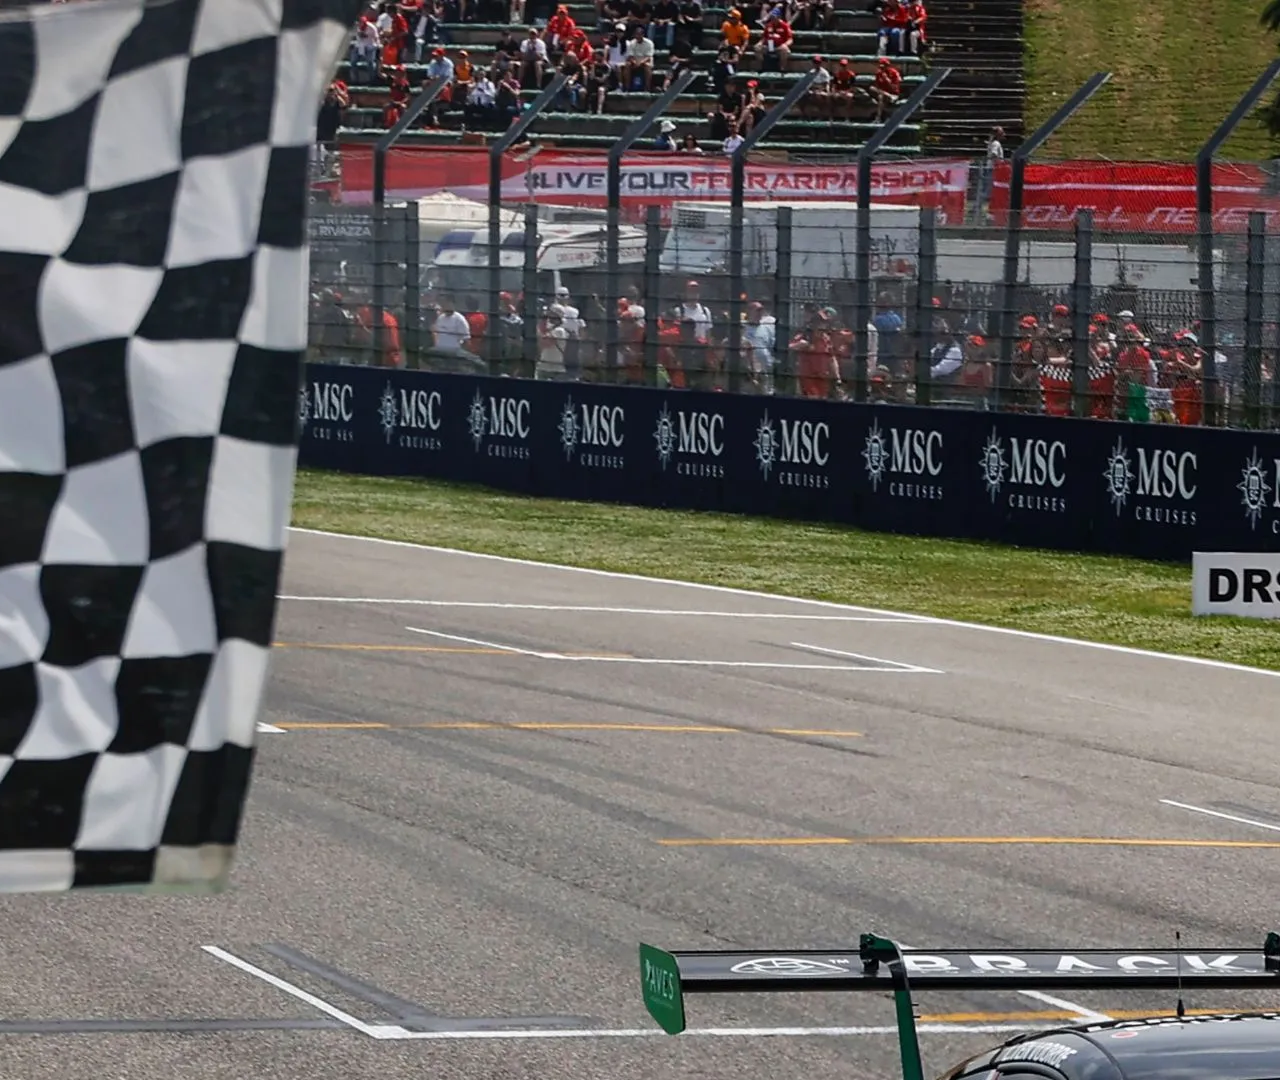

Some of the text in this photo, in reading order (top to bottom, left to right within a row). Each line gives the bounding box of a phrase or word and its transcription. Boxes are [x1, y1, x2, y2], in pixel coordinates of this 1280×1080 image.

[313, 382, 352, 422] MSC
[400, 389, 441, 430] MSC
[490, 397, 530, 439] MSC
[581, 404, 623, 447] MSC
[313, 426, 353, 441] CRUSES
[400, 435, 441, 450] CRUISES
[678, 411, 723, 456] MSC
[780, 419, 828, 466] MSC
[488, 444, 530, 460] CRUISES
[581, 454, 623, 469] CRUISES
[890, 428, 942, 476] MSC
[1010, 437, 1066, 487] MSC
[677, 462, 723, 478] CRUISES
[779, 472, 828, 488] CRUISES
[1137, 447, 1197, 500] MSC
[890, 482, 942, 500] CRUISES
[1009, 494, 1065, 512] CRUISES
[1136, 506, 1196, 525] CRUISES
